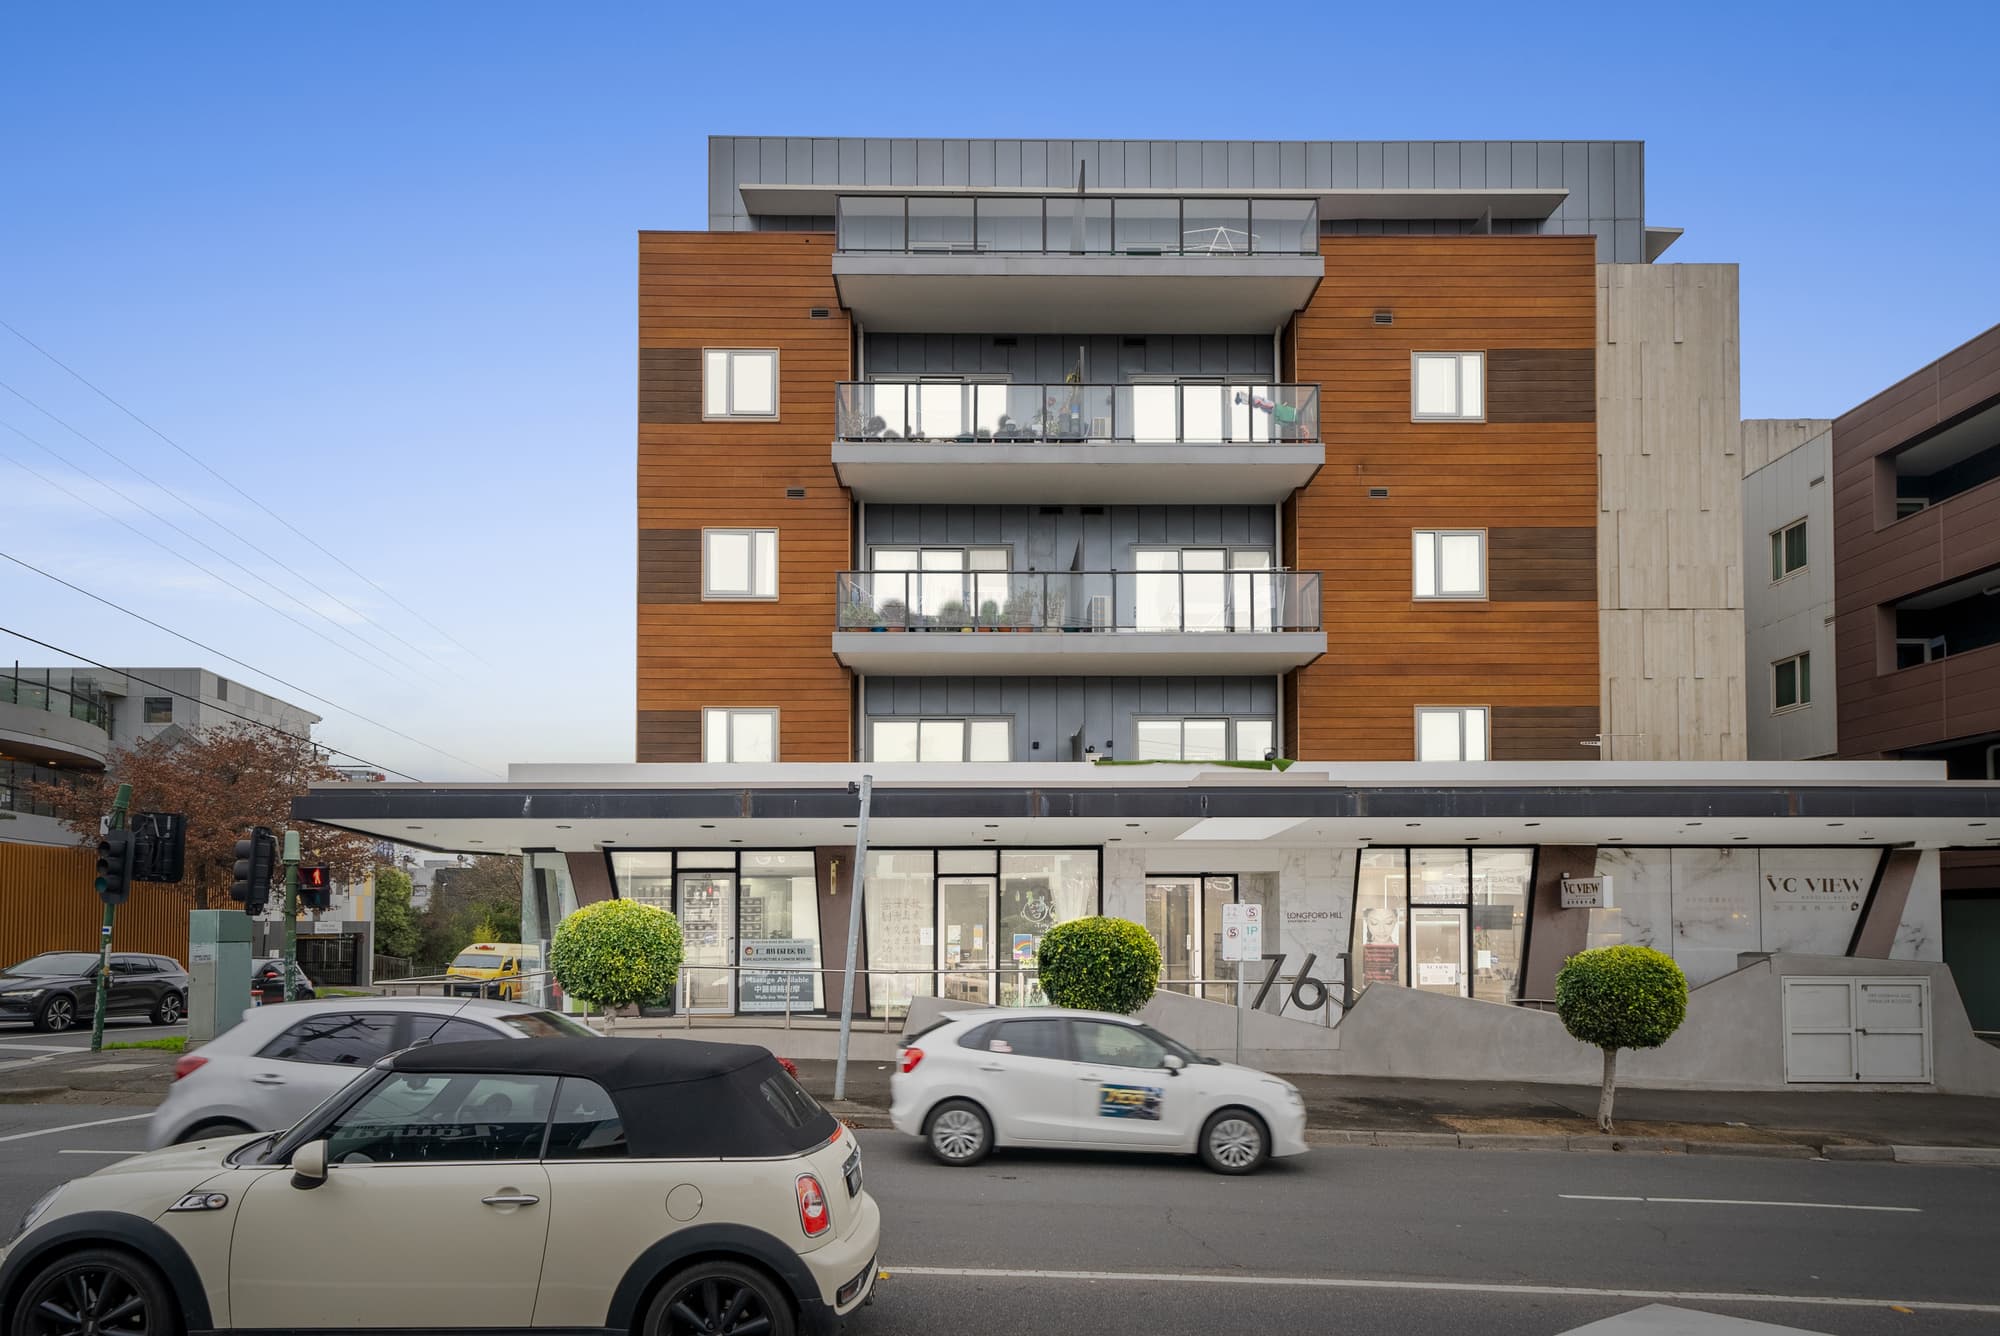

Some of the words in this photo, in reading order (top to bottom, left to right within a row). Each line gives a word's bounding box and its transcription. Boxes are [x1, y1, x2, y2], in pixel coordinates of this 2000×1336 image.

[1563, 882, 1575, 894] VC
[1577, 882, 1600, 894] VIEW
[1767, 877, 1797, 893] VC
[1805, 878, 1863, 893] VIEW
[1286, 911, 1328, 919] LONGFORD
[1329, 911, 1344, 919] HILL
[1251, 952, 1353, 1010] 761
